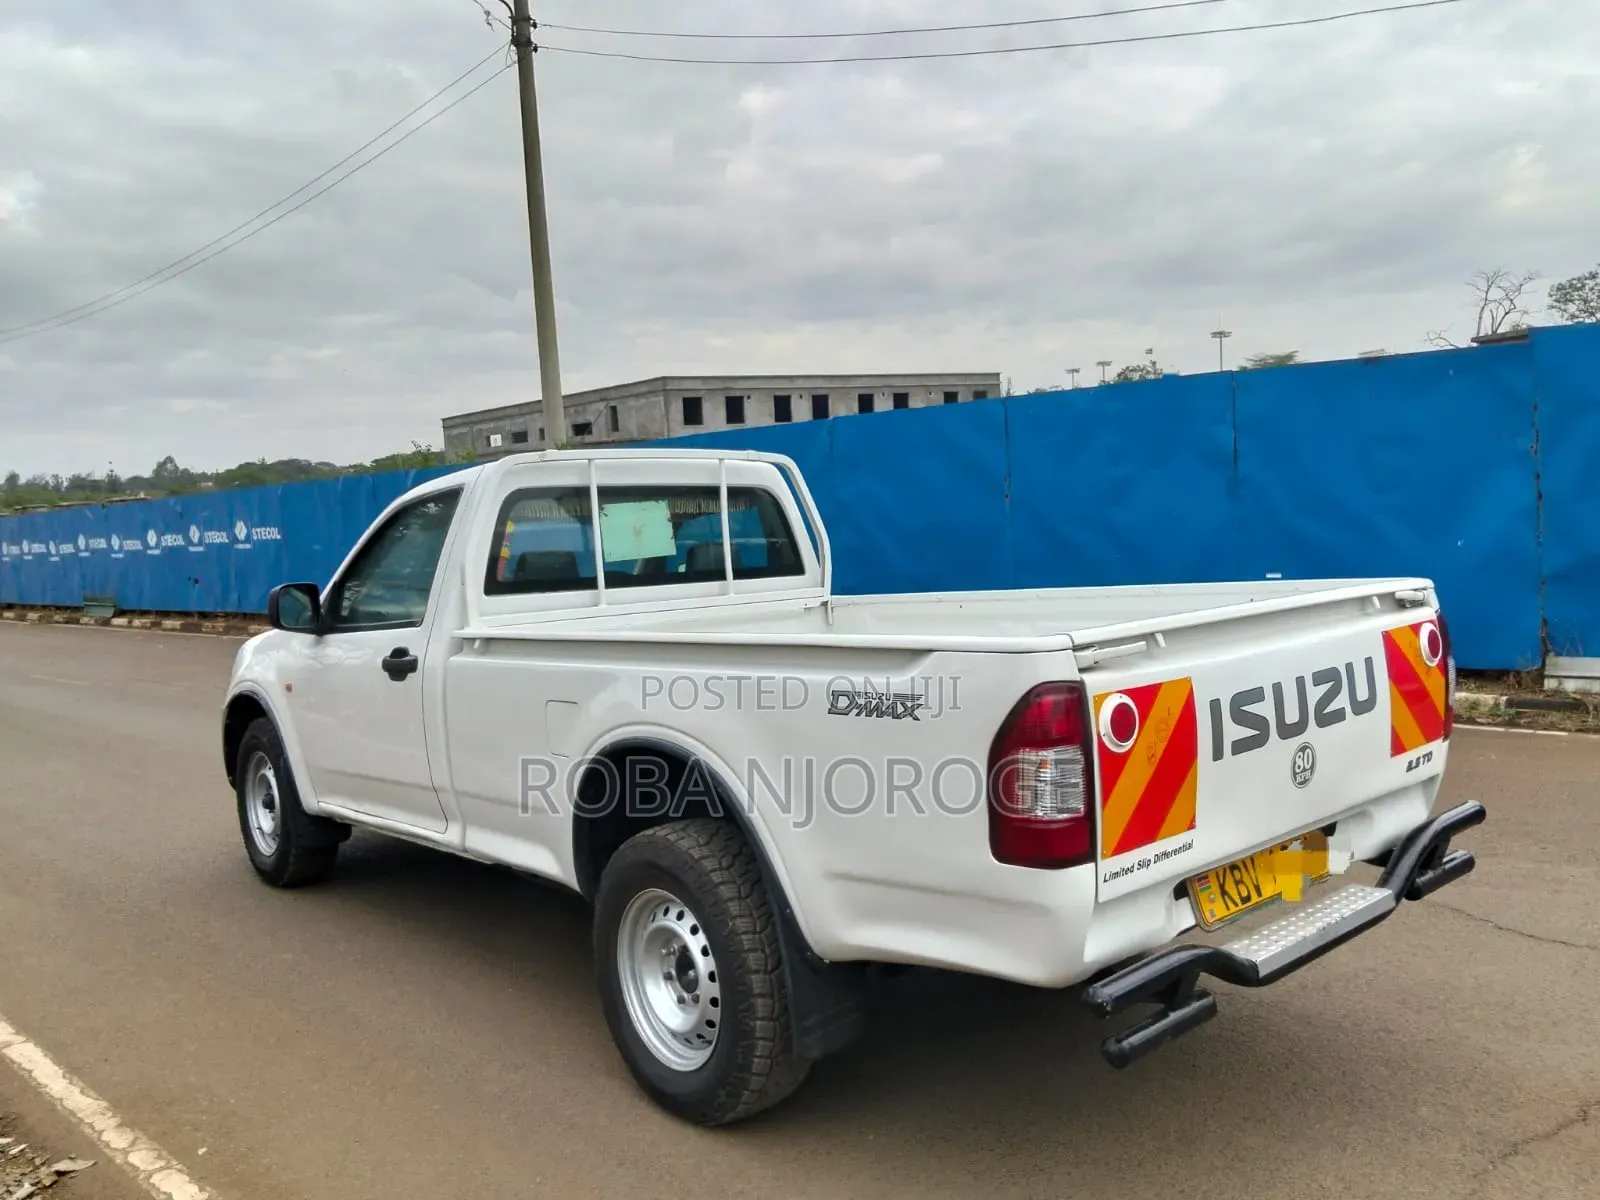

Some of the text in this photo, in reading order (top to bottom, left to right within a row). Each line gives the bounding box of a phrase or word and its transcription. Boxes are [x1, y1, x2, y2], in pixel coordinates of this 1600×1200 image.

[161, 534, 185, 547] STECOL
[204, 531, 229, 544] STECOL
[252, 527, 281, 540] STECOL
[1209, 656, 1377, 762] ISUZU
[1295, 748, 1313, 773] 80
[1103, 839, 1194, 883] Limited Slip Differential
[1215, 856, 1263, 911] KBV
